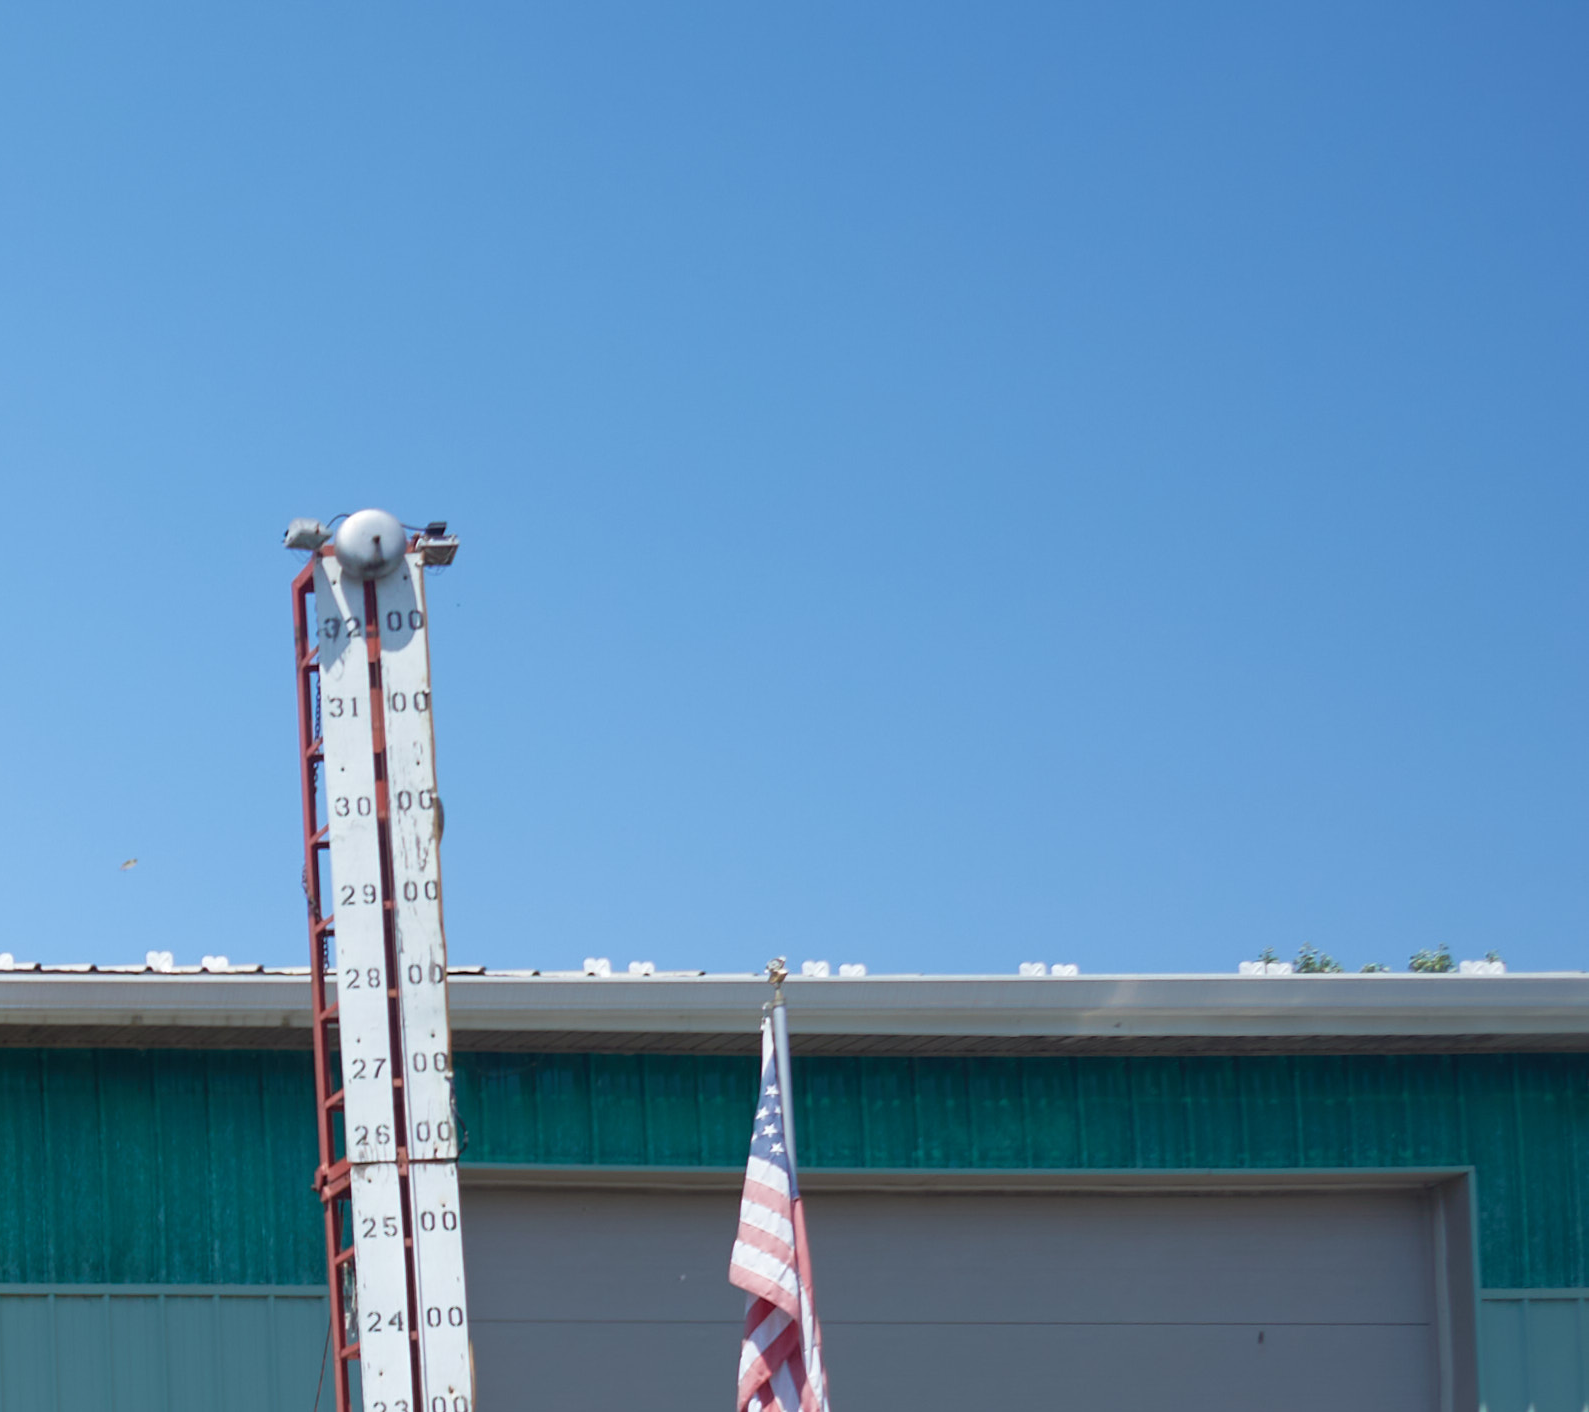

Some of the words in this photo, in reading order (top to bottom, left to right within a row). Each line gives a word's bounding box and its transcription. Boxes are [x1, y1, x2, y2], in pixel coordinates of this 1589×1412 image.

[323, 616, 362, 639] 32
[328, 696, 359, 718] 31
[391, 691, 429, 713] 00
[334, 796, 371, 817] 30
[396, 789, 433, 811] 00
[340, 884, 378, 906] 29
[402, 879, 438, 902] 00
[345, 967, 381, 989] 28
[408, 963, 444, 985] 00
[351, 1058, 386, 1080] 27
[412, 1051, 448, 1073] 00
[354, 1124, 391, 1146] 26
[416, 1120, 452, 1143] 00
[361, 1215, 398, 1238] 25
[420, 1210, 457, 1232] 00
[366, 1310, 404, 1333] 24
[425, 1305, 464, 1328] 00
